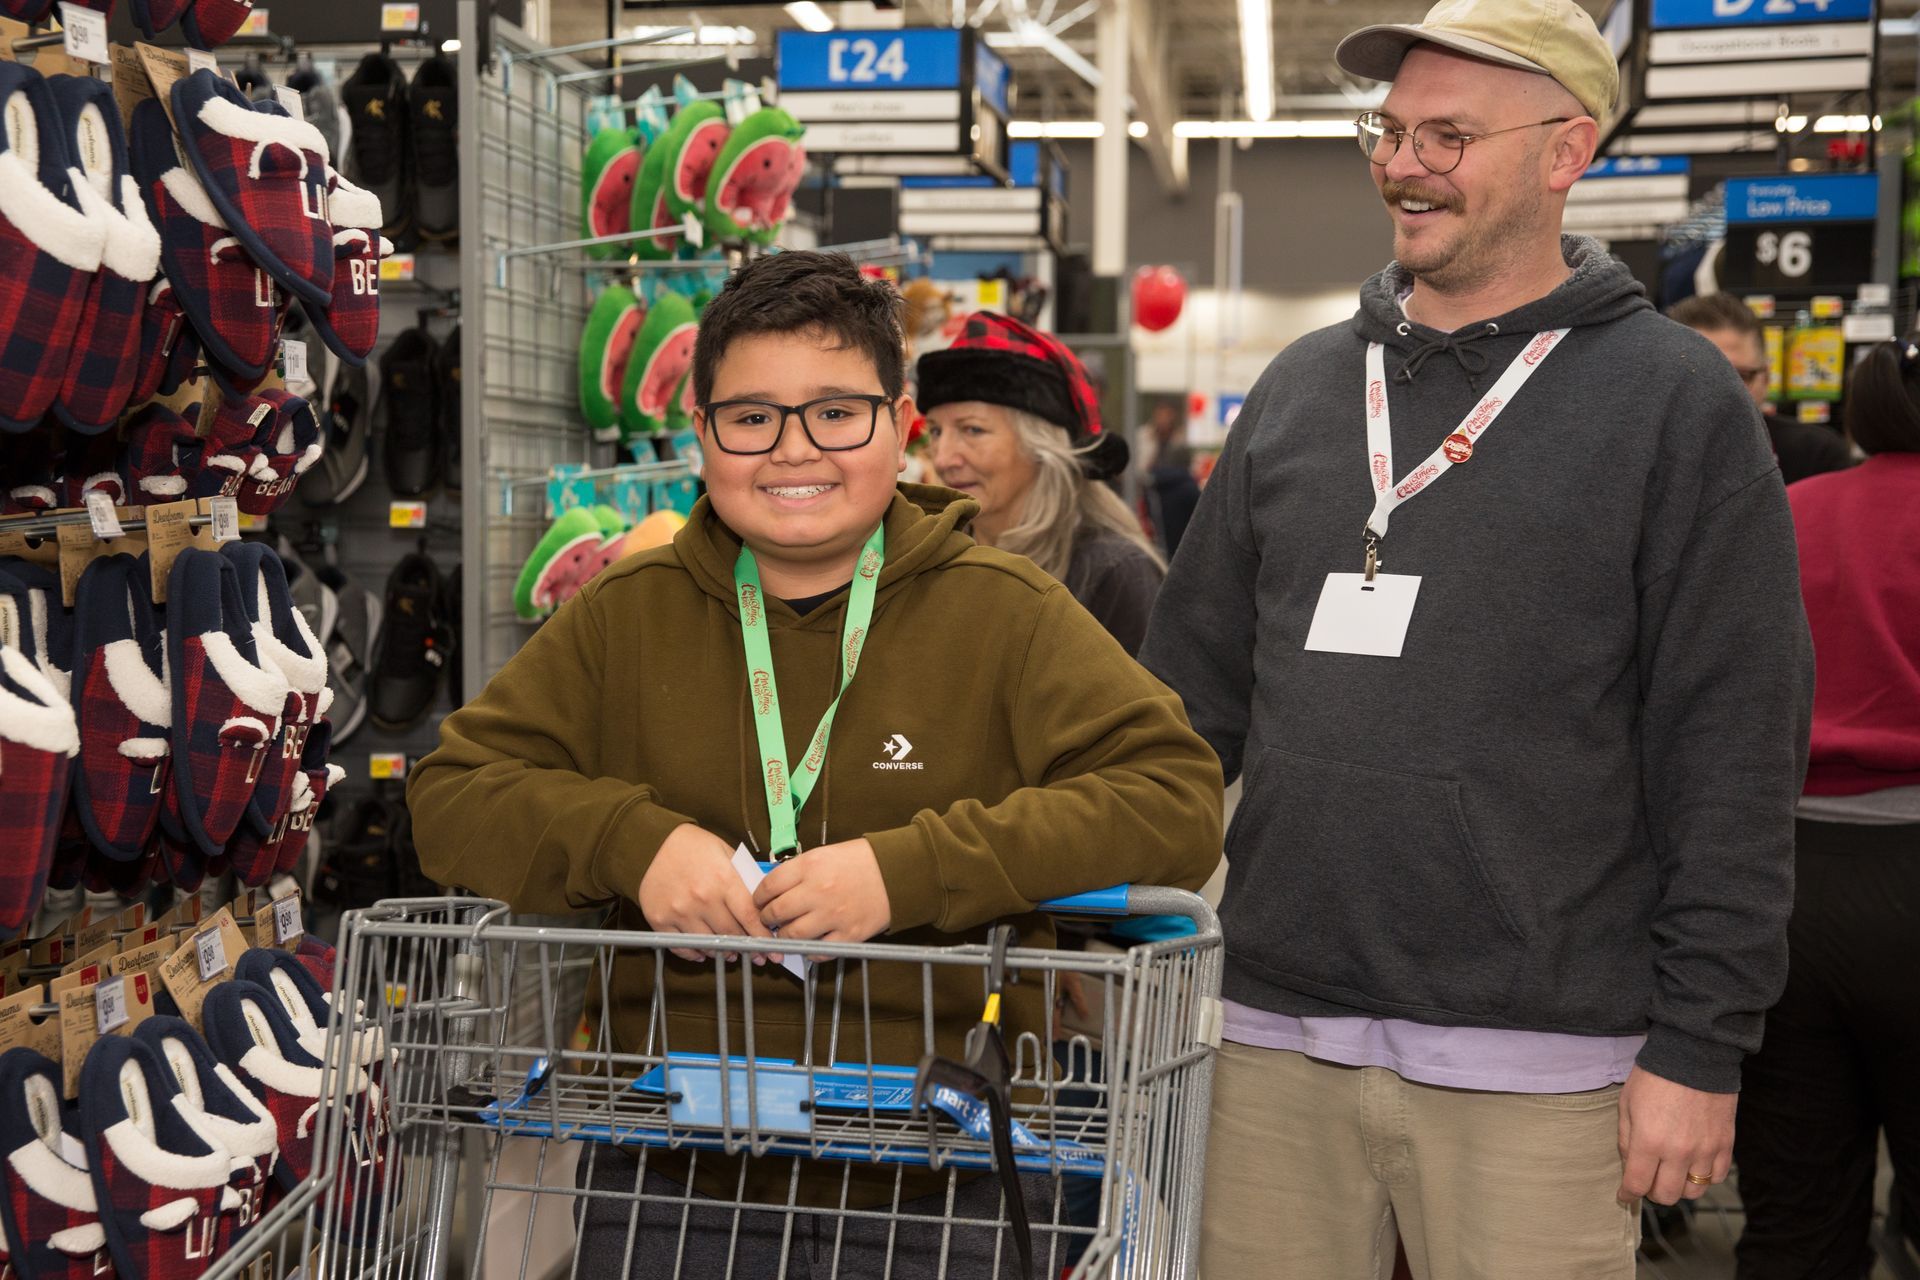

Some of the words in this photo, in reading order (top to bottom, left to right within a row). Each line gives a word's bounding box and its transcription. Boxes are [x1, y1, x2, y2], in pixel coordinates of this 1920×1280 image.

[1748, 199, 1782, 217] Low
[1785, 197, 1831, 216] Price
[1756, 231, 1812, 278] $6
[1465, 397, 1503, 436] Christmas
[1396, 464, 1439, 499] Christmas
[741, 583, 763, 627] Christmas
[753, 667, 776, 716] Christmas
[767, 758, 788, 806] Christmas
[872, 761, 924, 770] CONVERSE
[119, 950, 160, 972] Dearfoams
